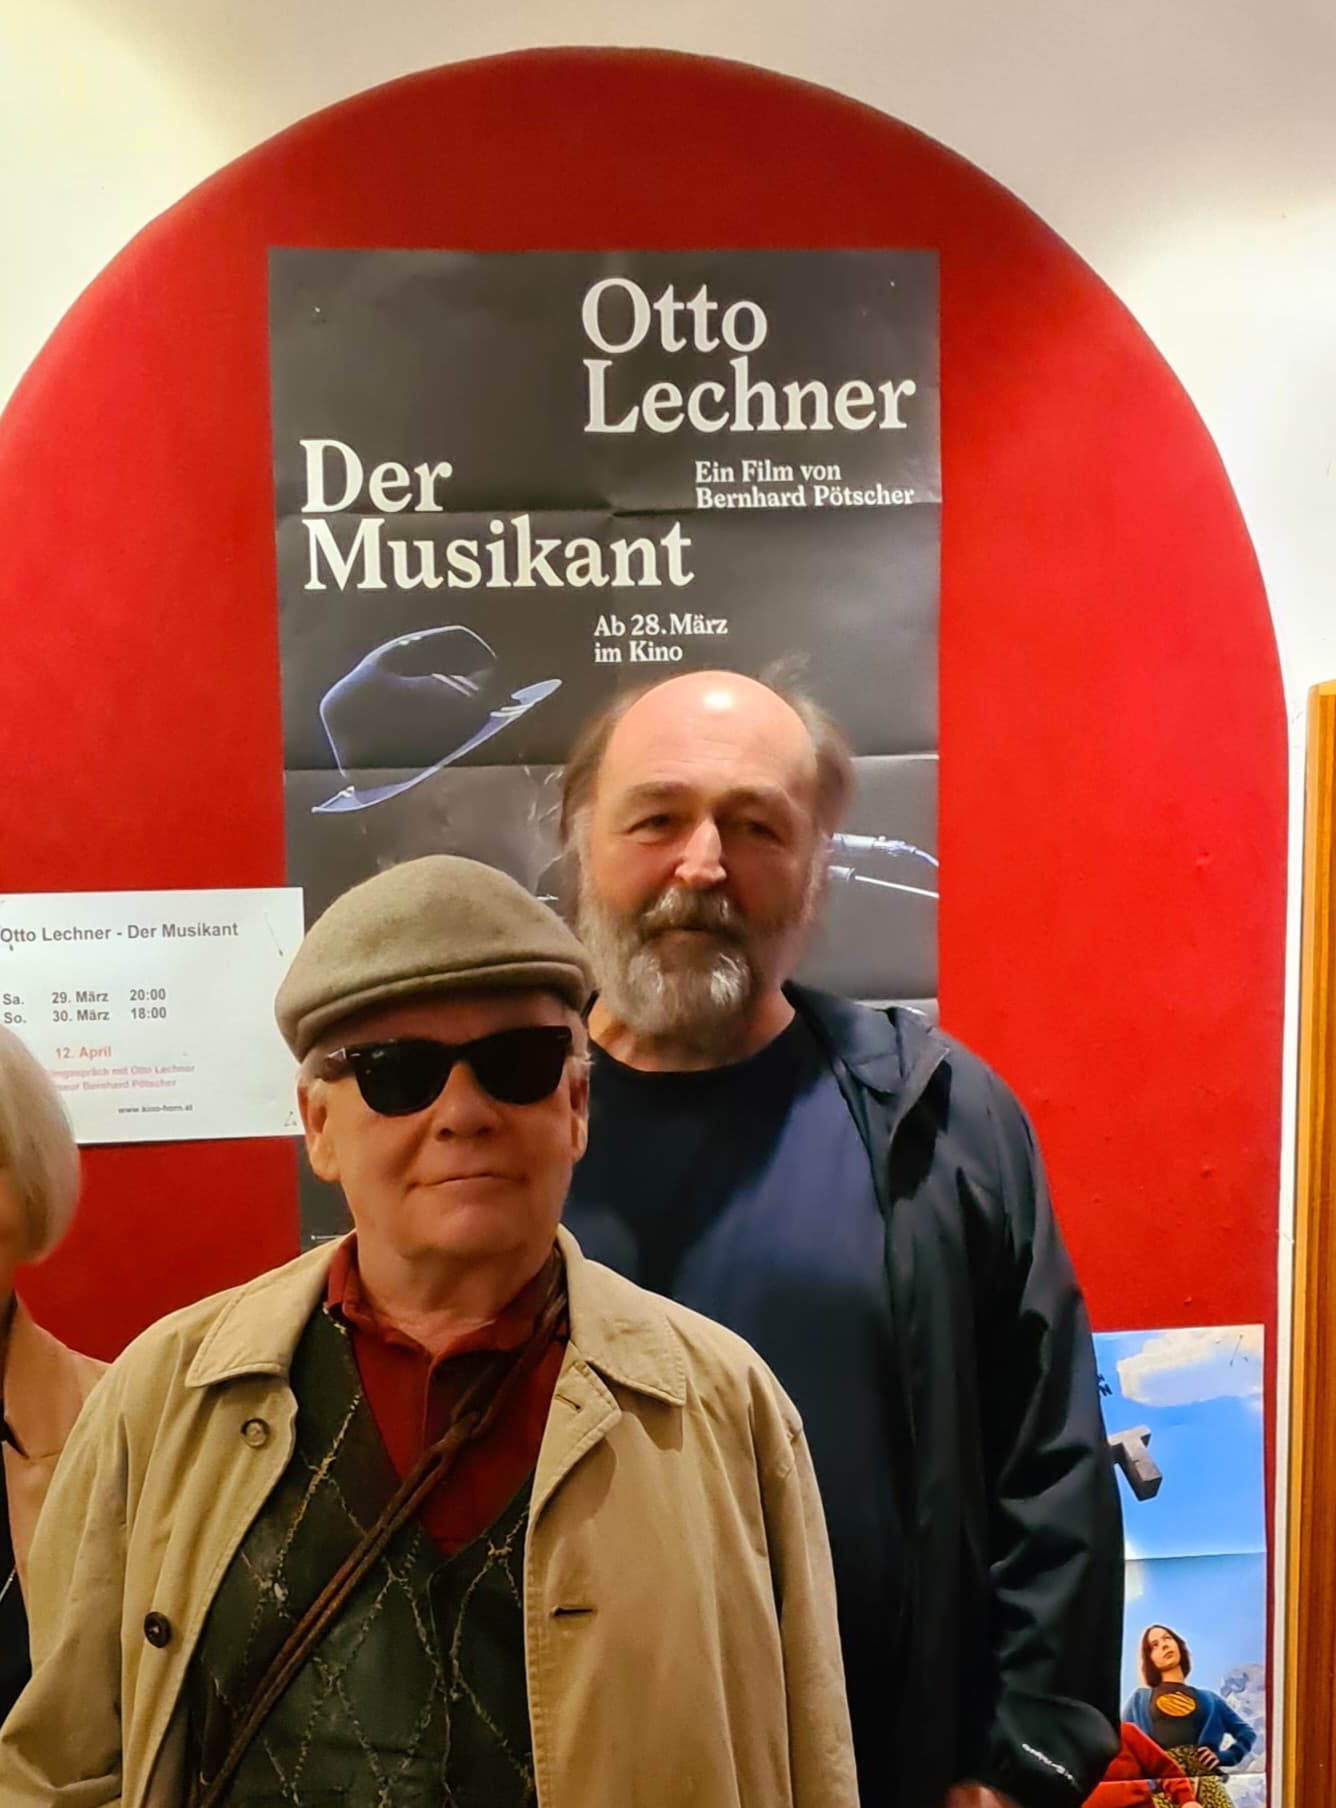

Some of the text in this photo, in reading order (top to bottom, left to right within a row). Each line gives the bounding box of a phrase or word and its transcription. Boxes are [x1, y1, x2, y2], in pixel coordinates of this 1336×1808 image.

[582, 277, 768, 354] Otto
[583, 356, 916, 434] Lechner
[299, 438, 452, 515] Der
[695, 459, 841, 483] Ein Film von
[695, 483, 915, 509] Bernhard Pötscher
[302, 515, 695, 591] Musikant
[594, 614, 626, 637] Ab
[595, 640, 683, 662] im Kino
[0, 927, 37, 943] Otto
[42, 926, 112, 942] Lechner
[127, 924, 157, 939] Der
[162, 922, 239, 938] Musikant
[2, 988, 166, 1006] Sa. 29. März 20:00
[3, 1007, 167, 1024] So. 30. März 18:00
[56, 1046, 112, 1060] 12. April
